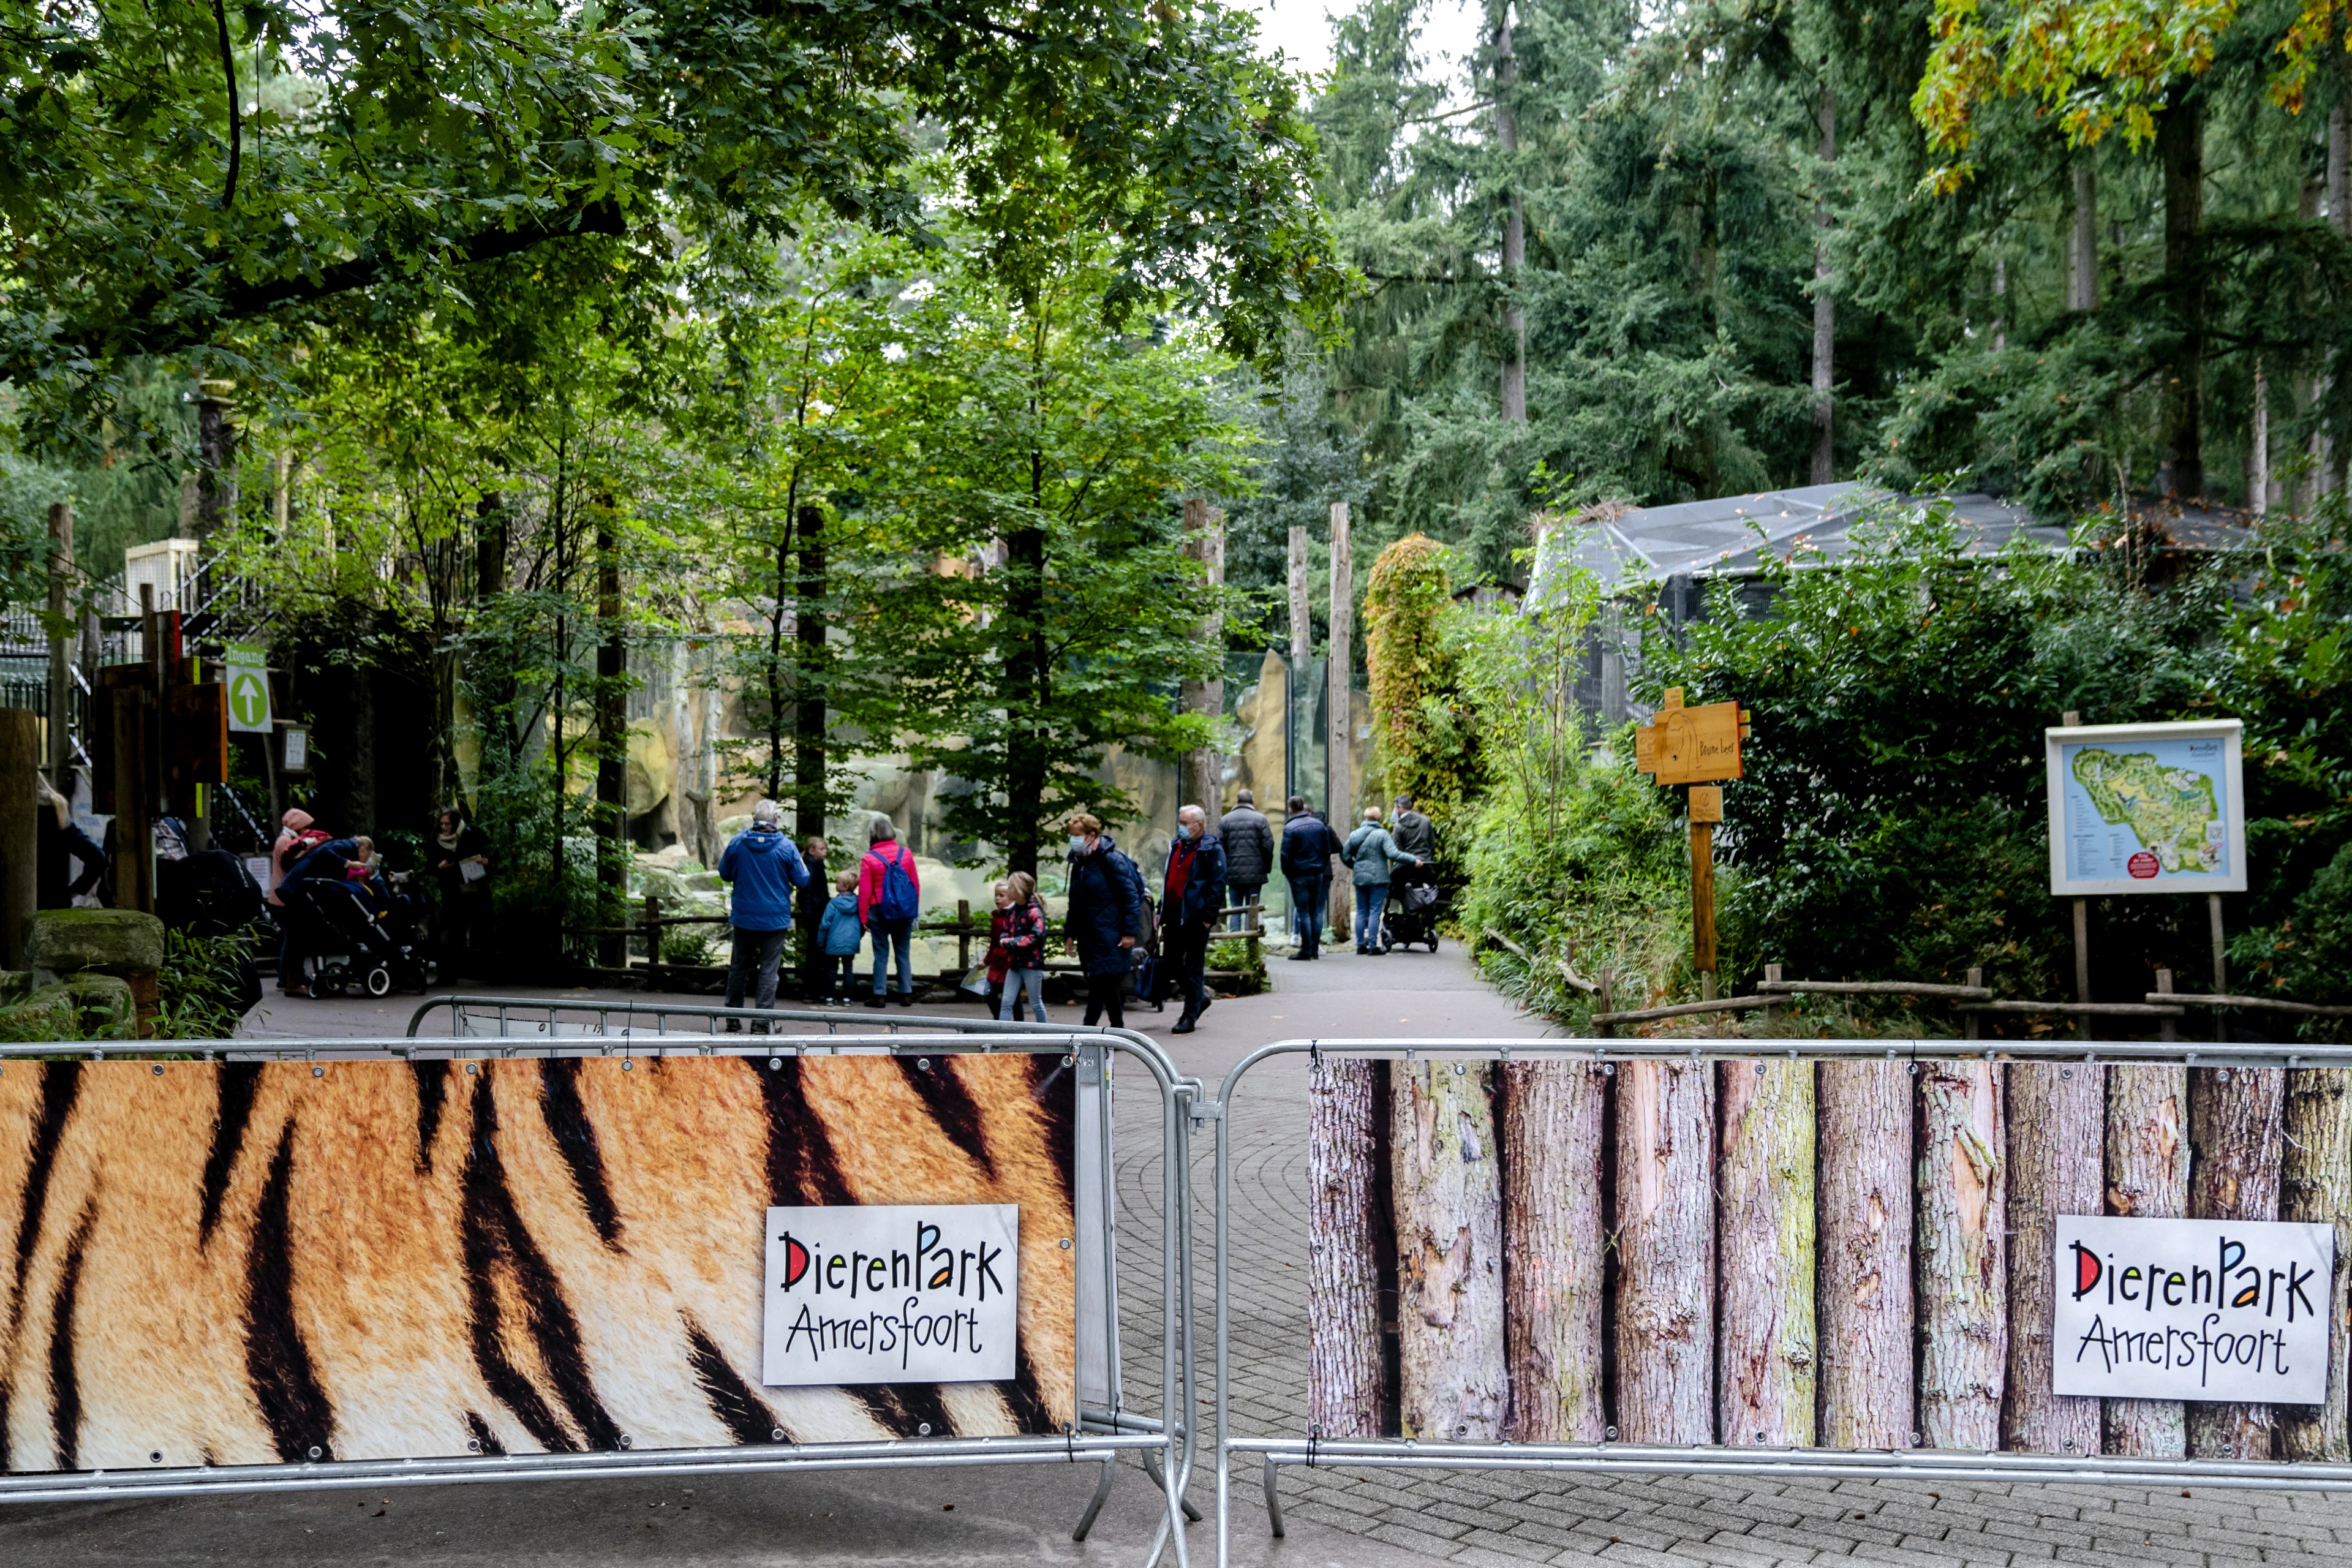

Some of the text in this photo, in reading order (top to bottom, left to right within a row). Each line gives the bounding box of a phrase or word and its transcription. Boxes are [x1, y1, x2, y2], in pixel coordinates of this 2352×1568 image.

[227, 645, 264, 667] Ingang
[1700, 738, 1734, 756] Bruine beer
[778, 1221, 1003, 1302] DierenPark
[2068, 1236, 2315, 1323] DierenPark
[785, 1296, 982, 1370] Amersfoort
[2076, 1313, 2290, 1387] Amersfoort
